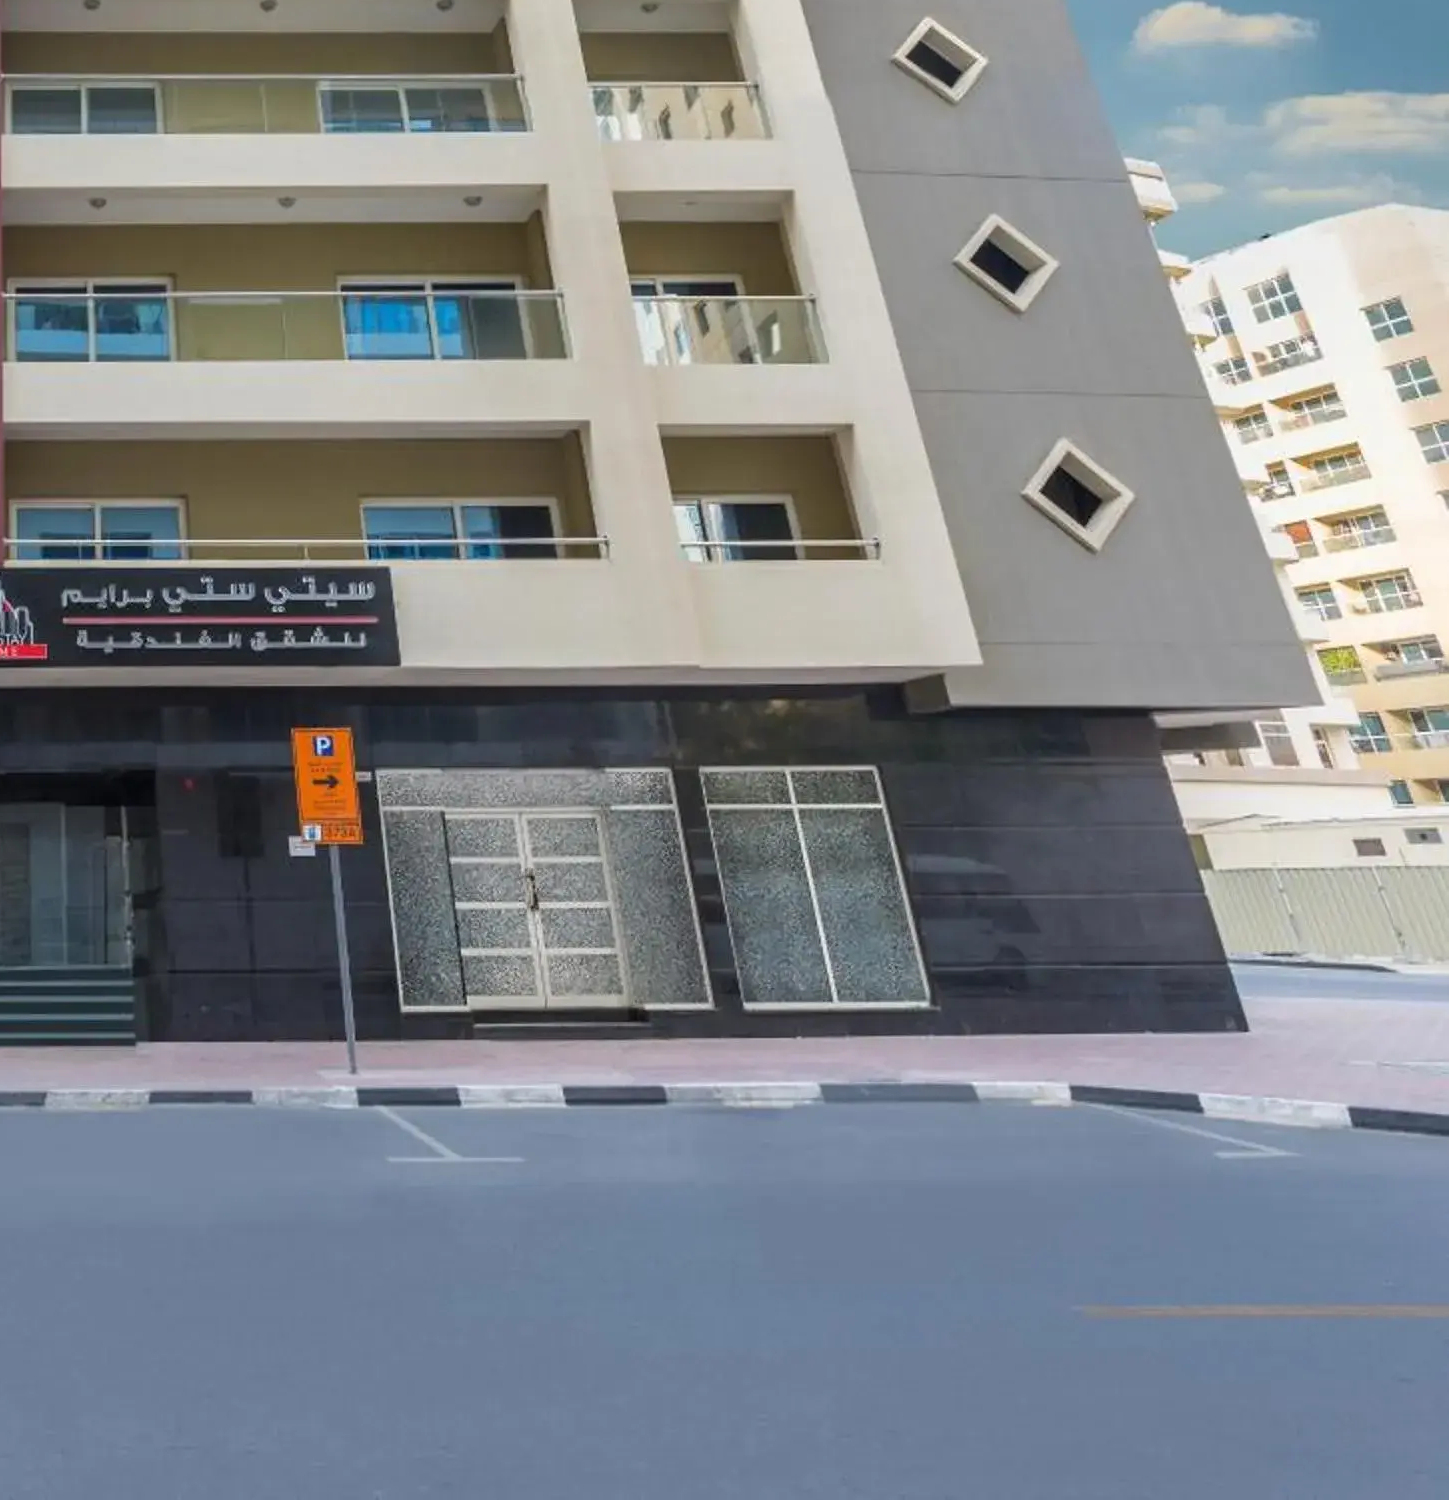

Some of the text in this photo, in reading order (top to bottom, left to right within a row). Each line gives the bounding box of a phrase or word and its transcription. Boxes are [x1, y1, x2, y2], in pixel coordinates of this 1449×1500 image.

[61, 576, 376, 613] سيتي ستي برايم
[76, 626, 367, 653] للشقق الفندقية
[316, 736, 332, 756] P
